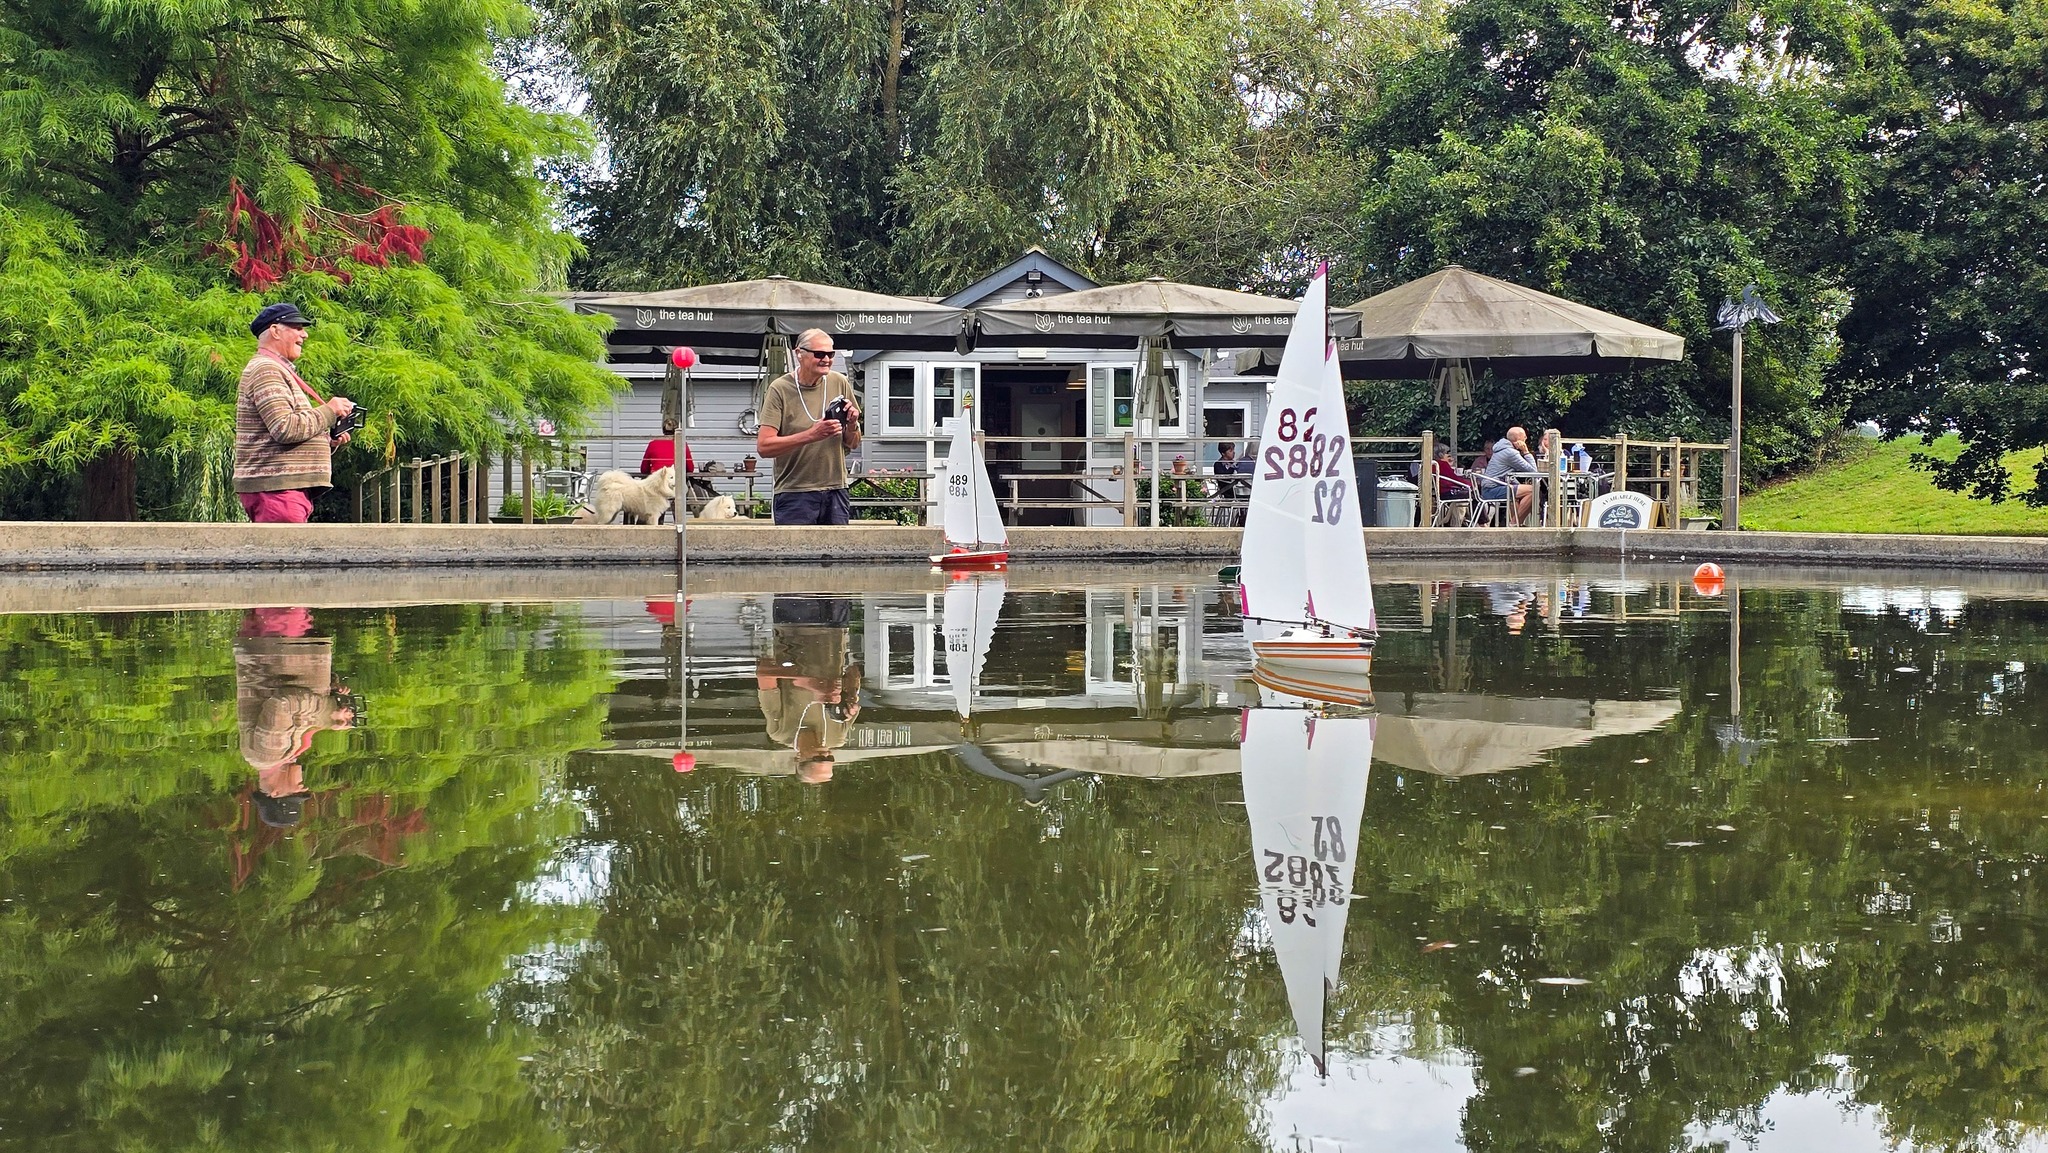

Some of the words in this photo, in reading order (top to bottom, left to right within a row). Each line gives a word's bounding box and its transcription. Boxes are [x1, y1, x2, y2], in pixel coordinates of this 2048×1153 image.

[659, 309, 676, 320] the
[678, 309, 694, 321] tea
[697, 310, 714, 321] hut
[858, 313, 875, 324] the
[877, 313, 893, 324] tea
[895, 313, 912, 325] hut
[1057, 313, 1074, 324] the
[1076, 314, 1092, 325] tea
[1094, 315, 1111, 325] hut
[1254, 315, 1271, 325] the
[1273, 316, 1290, 325] tea
[1351, 340, 1364, 351] hut
[949, 474, 968, 486] 489
[1632, 496, 1647, 507] HERE
[1701, 565, 1711, 576] 3
